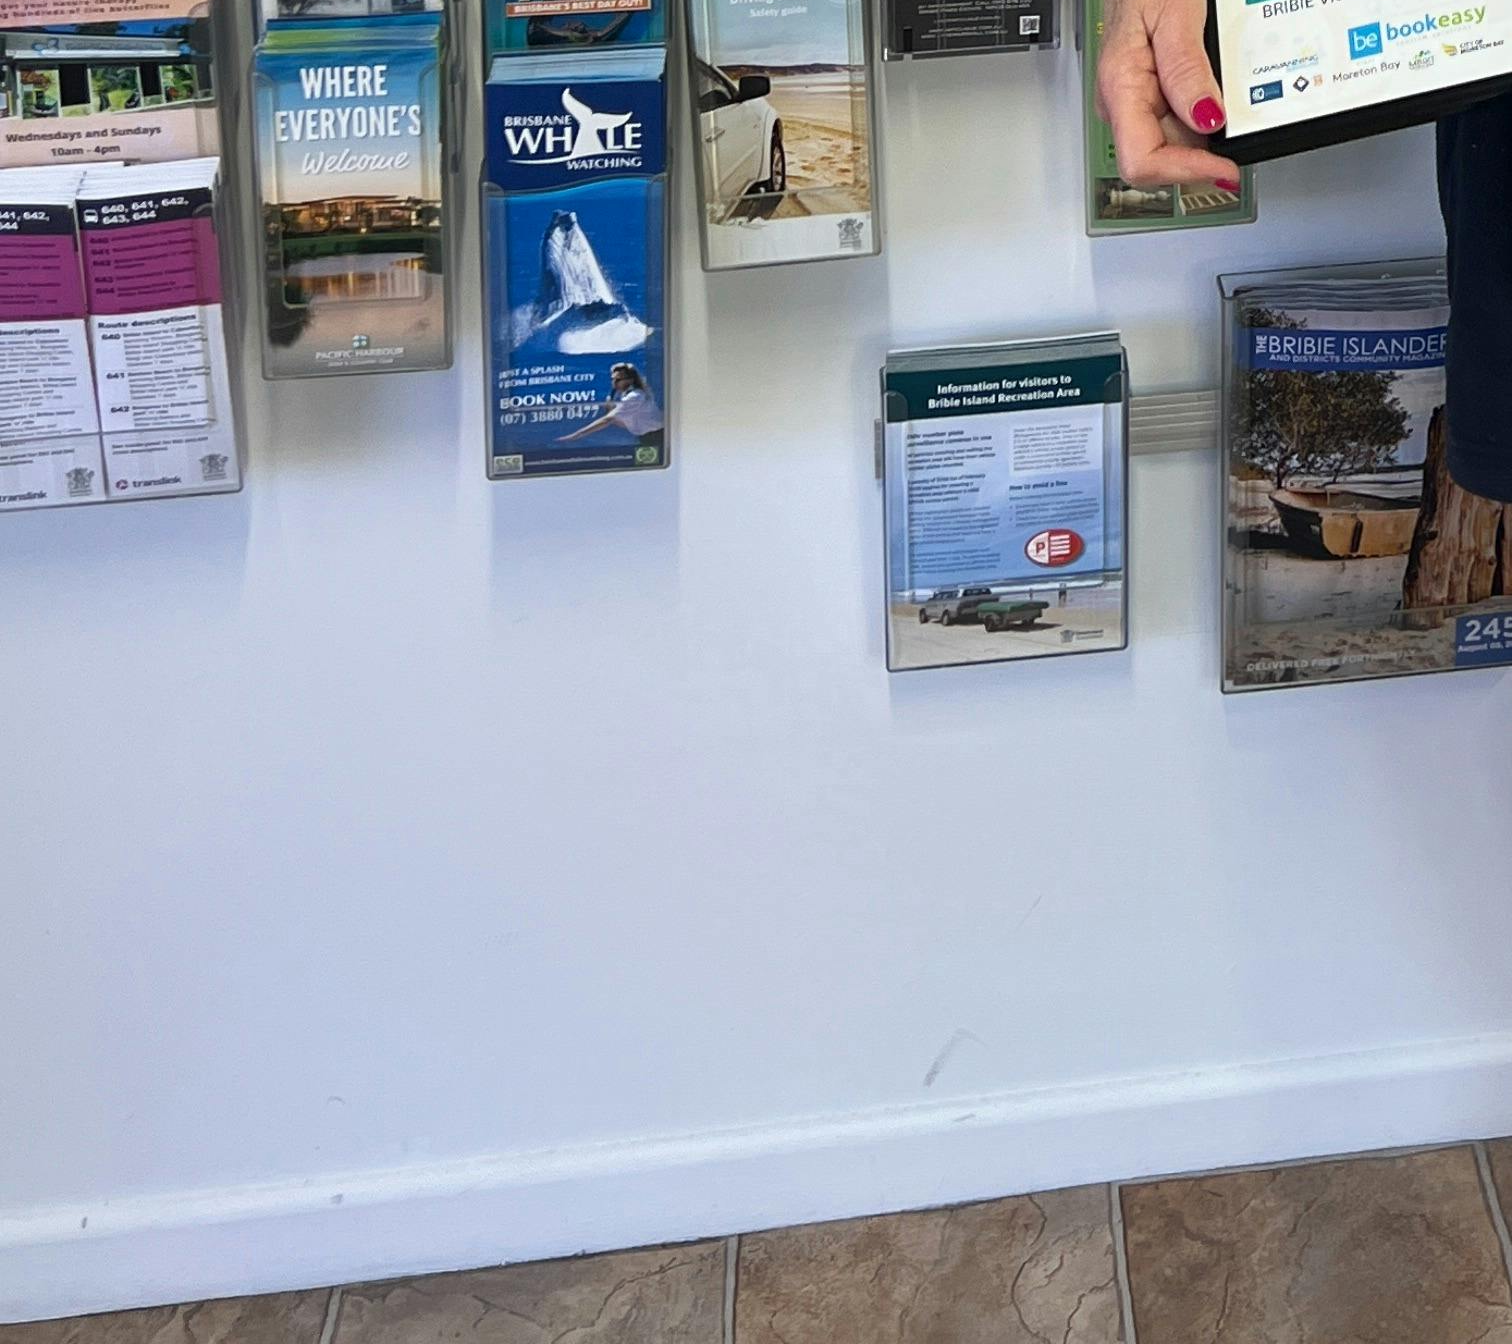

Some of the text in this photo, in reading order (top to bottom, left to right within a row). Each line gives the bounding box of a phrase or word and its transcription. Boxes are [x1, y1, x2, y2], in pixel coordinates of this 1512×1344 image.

[1385, 5, 1486, 42] bookeasy
[300, 65, 387, 99] WHERE
[504, 115, 572, 127] BRISBANE
[6, 125, 161, 143] Wednesdays and Sundays
[302, 149, 411, 175] Welcome
[101, 196, 189, 214] 640, 641, 642,
[102, 211, 156, 224] 643, 644
[1255, 335, 1268, 354] THE
[1268, 336, 1336, 355] BRIBIE
[937, 374, 1072, 394] Information for visitors to
[500, 390, 595, 409] BOOK NOW!
[928, 387, 1081, 409] Bribie Island Recreation Area
